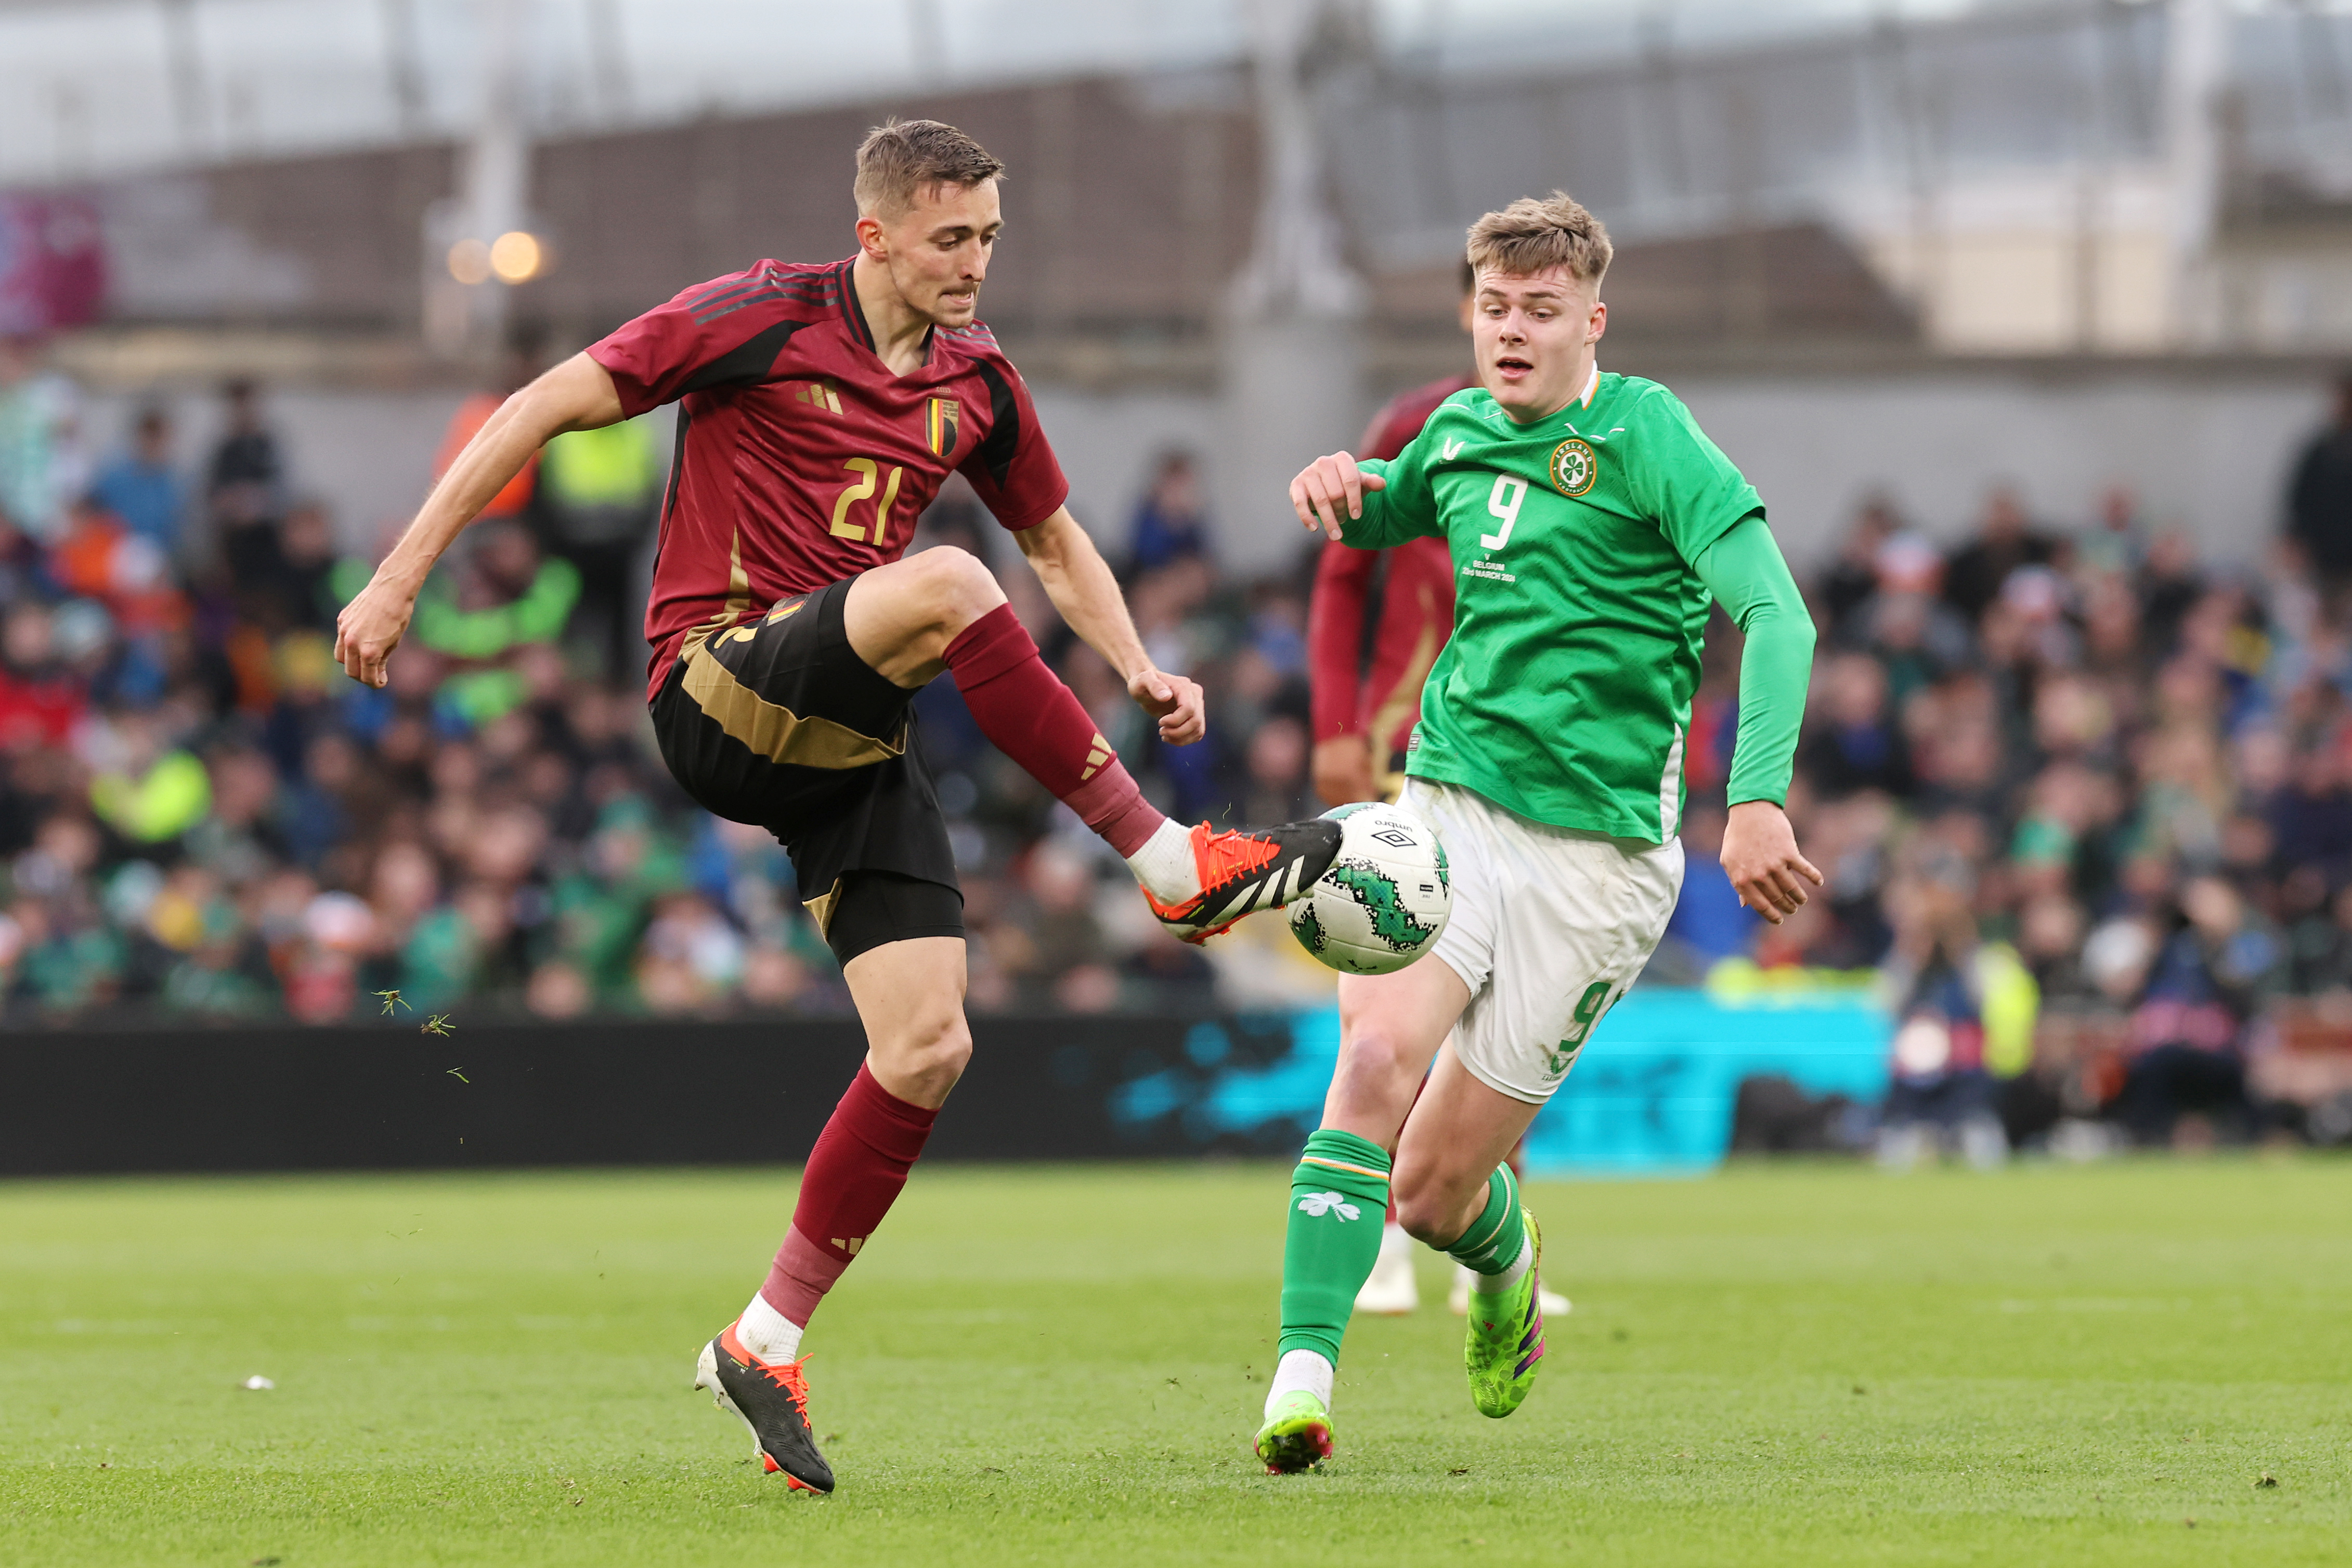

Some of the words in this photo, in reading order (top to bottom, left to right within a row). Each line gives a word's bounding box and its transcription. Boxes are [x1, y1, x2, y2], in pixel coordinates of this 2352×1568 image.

[1555, 442, 1593, 462] IRELAND
[829, 457, 903, 546] 21
[1480, 471, 1529, 551] 9
[1473, 560, 1505, 571] BELGIUM
[1374, 820, 1413, 832] umbro
[1558, 981, 1612, 1052] 9
